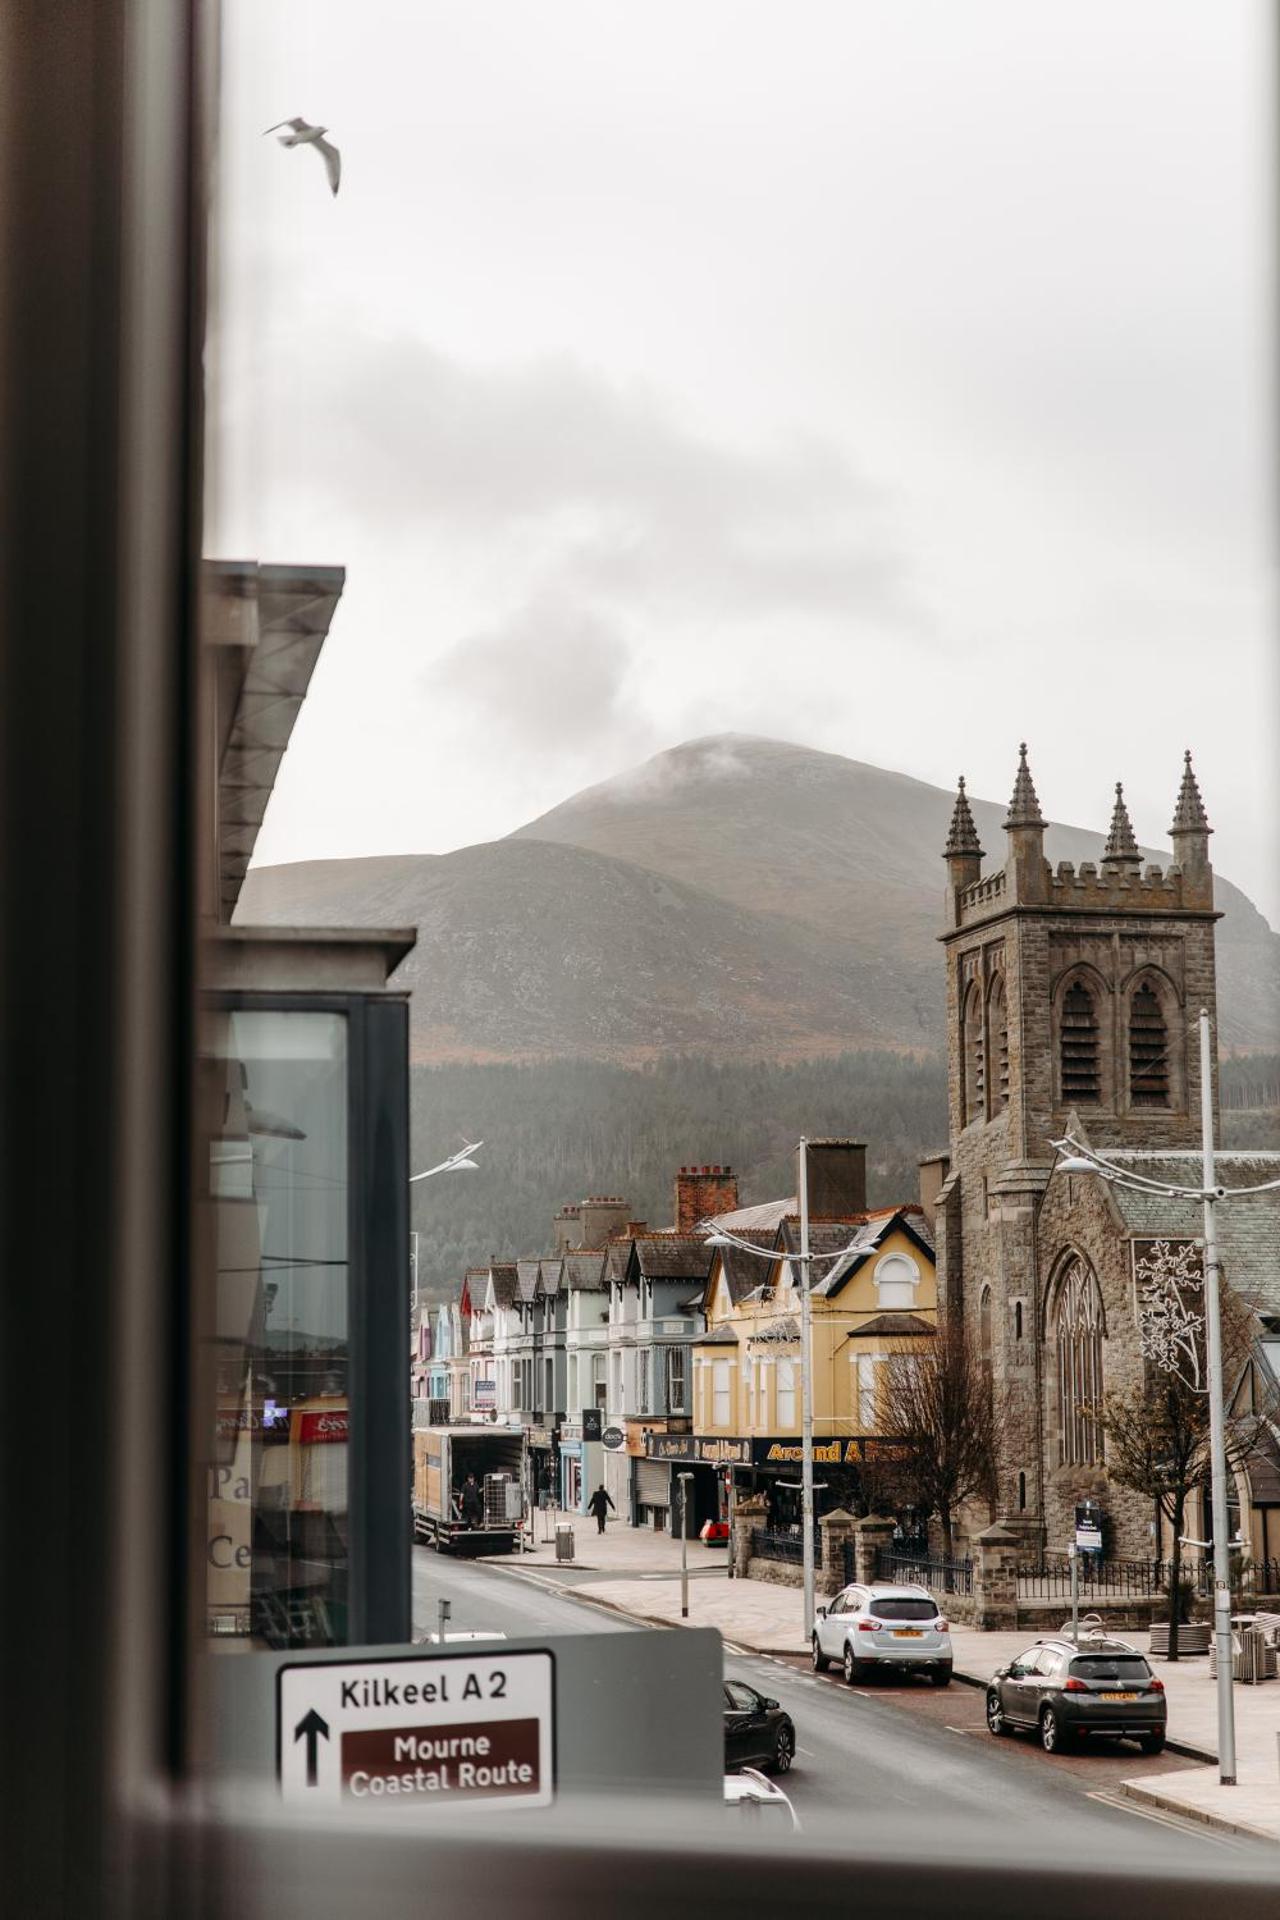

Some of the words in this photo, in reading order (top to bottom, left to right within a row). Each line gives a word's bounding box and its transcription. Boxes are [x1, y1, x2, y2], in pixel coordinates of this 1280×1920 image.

[767, 1440, 841, 1463] Arond
[341, 1675, 449, 1709] Kilkeel
[462, 1671, 507, 1699] A2
[394, 1736, 490, 1761] Mourne
[350, 1765, 449, 1797] Coastal
[459, 1759, 533, 1788] Route
